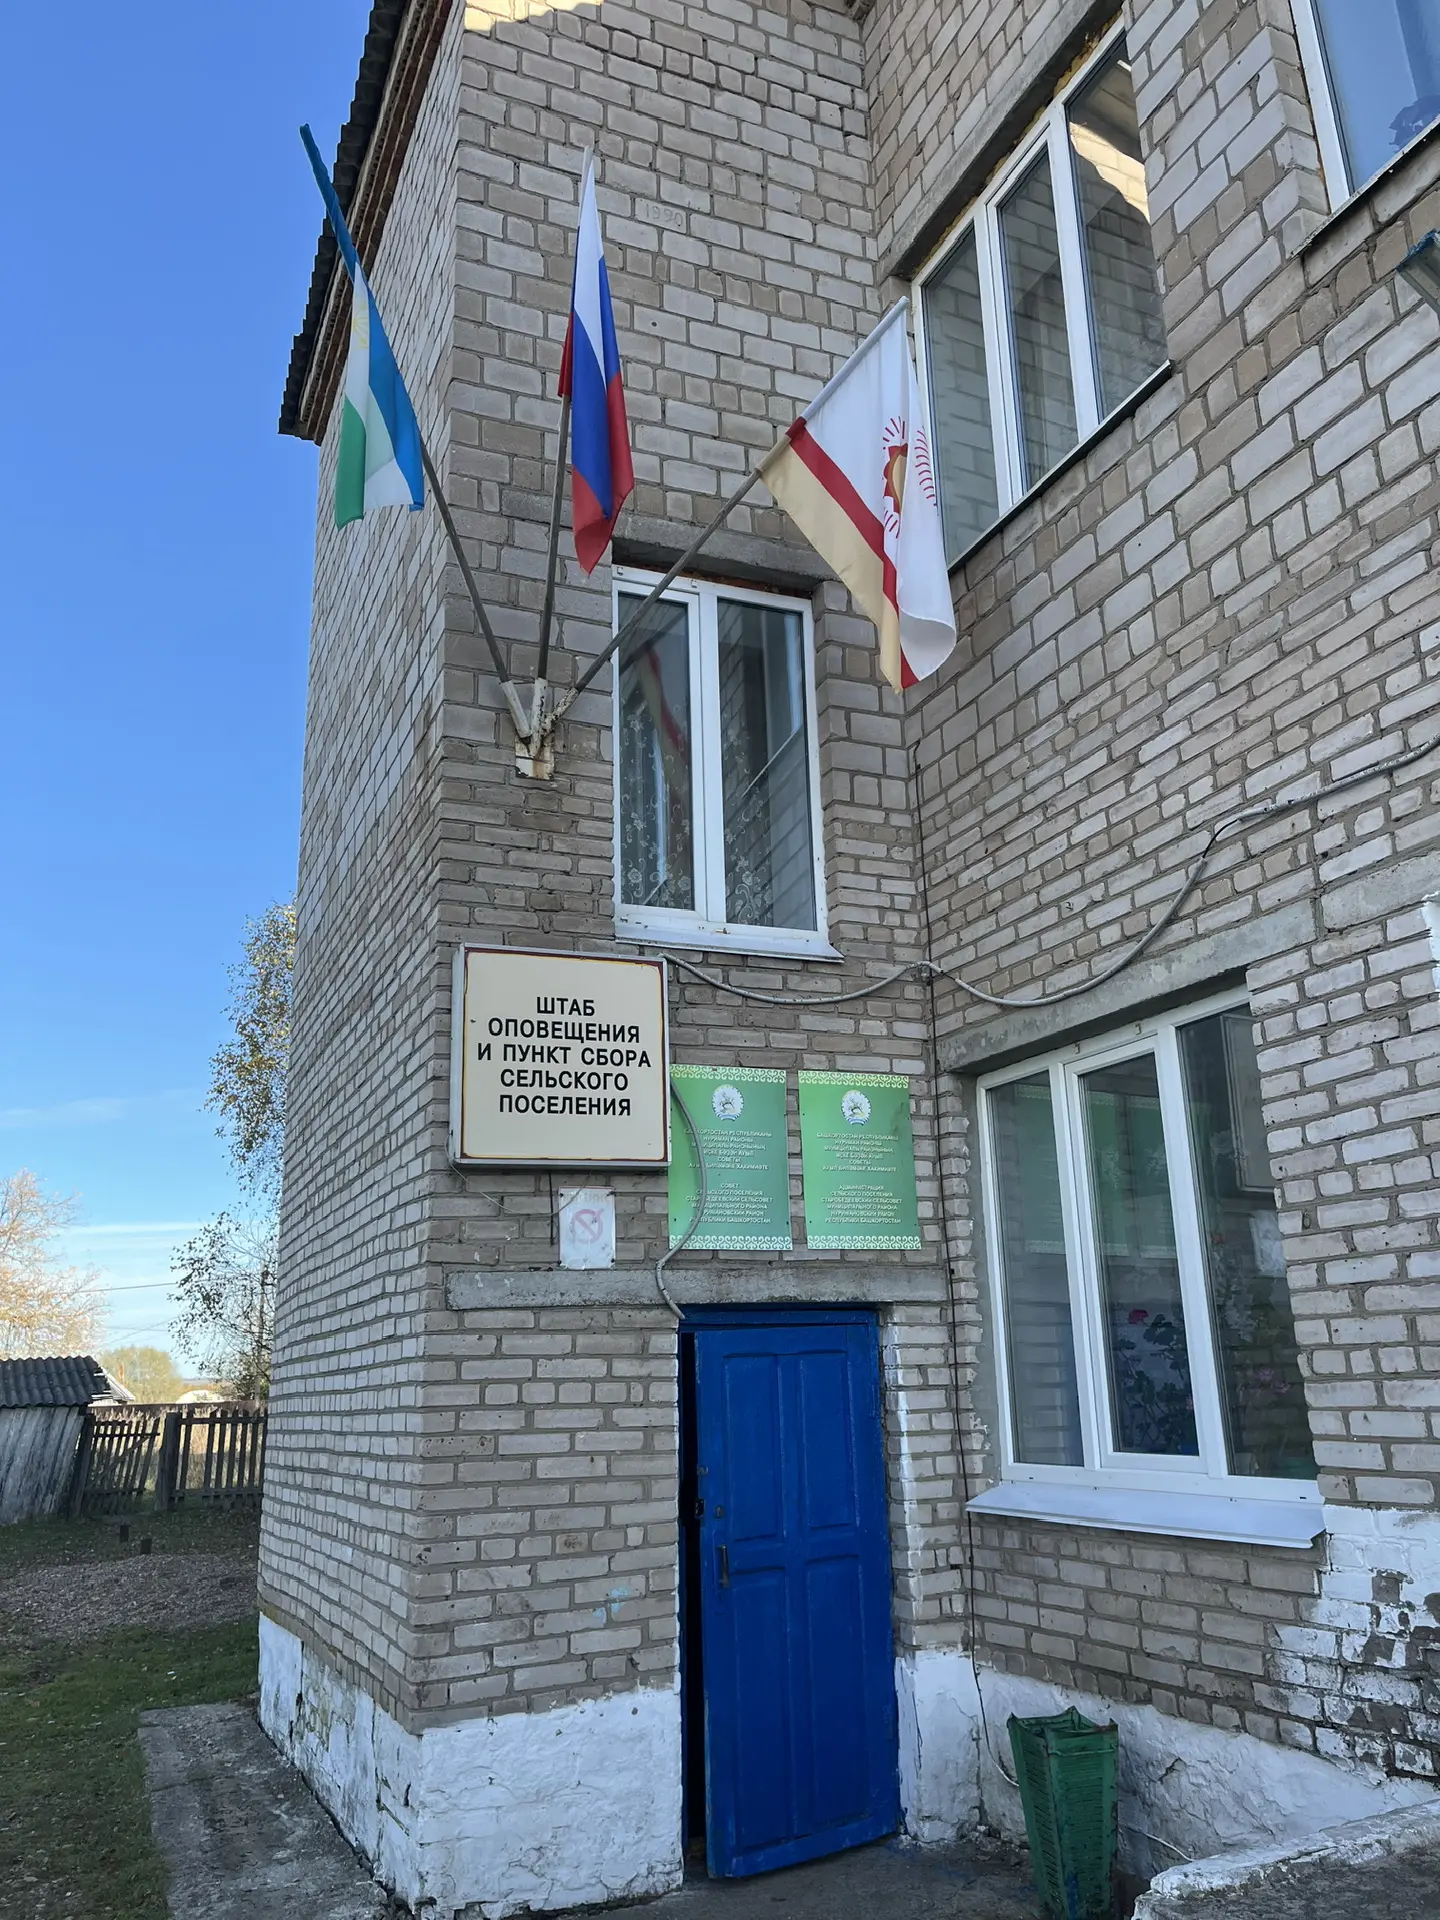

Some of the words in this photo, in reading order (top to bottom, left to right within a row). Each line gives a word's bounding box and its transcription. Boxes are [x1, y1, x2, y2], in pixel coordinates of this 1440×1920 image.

[646, 203, 684, 227] 1990
[536, 996, 595, 1016] ШТАБ
[488, 1017, 640, 1043] ОПОВЕЩЕНИЯ
[477, 1043, 491, 1061] И
[503, 1044, 571, 1064] ПУНКТ
[581, 1048, 651, 1067] СБОРА
[500, 1069, 628, 1091] СЕЛЬСКОГО
[500, 1095, 631, 1116] ПОСЕЛЕНИЯ
